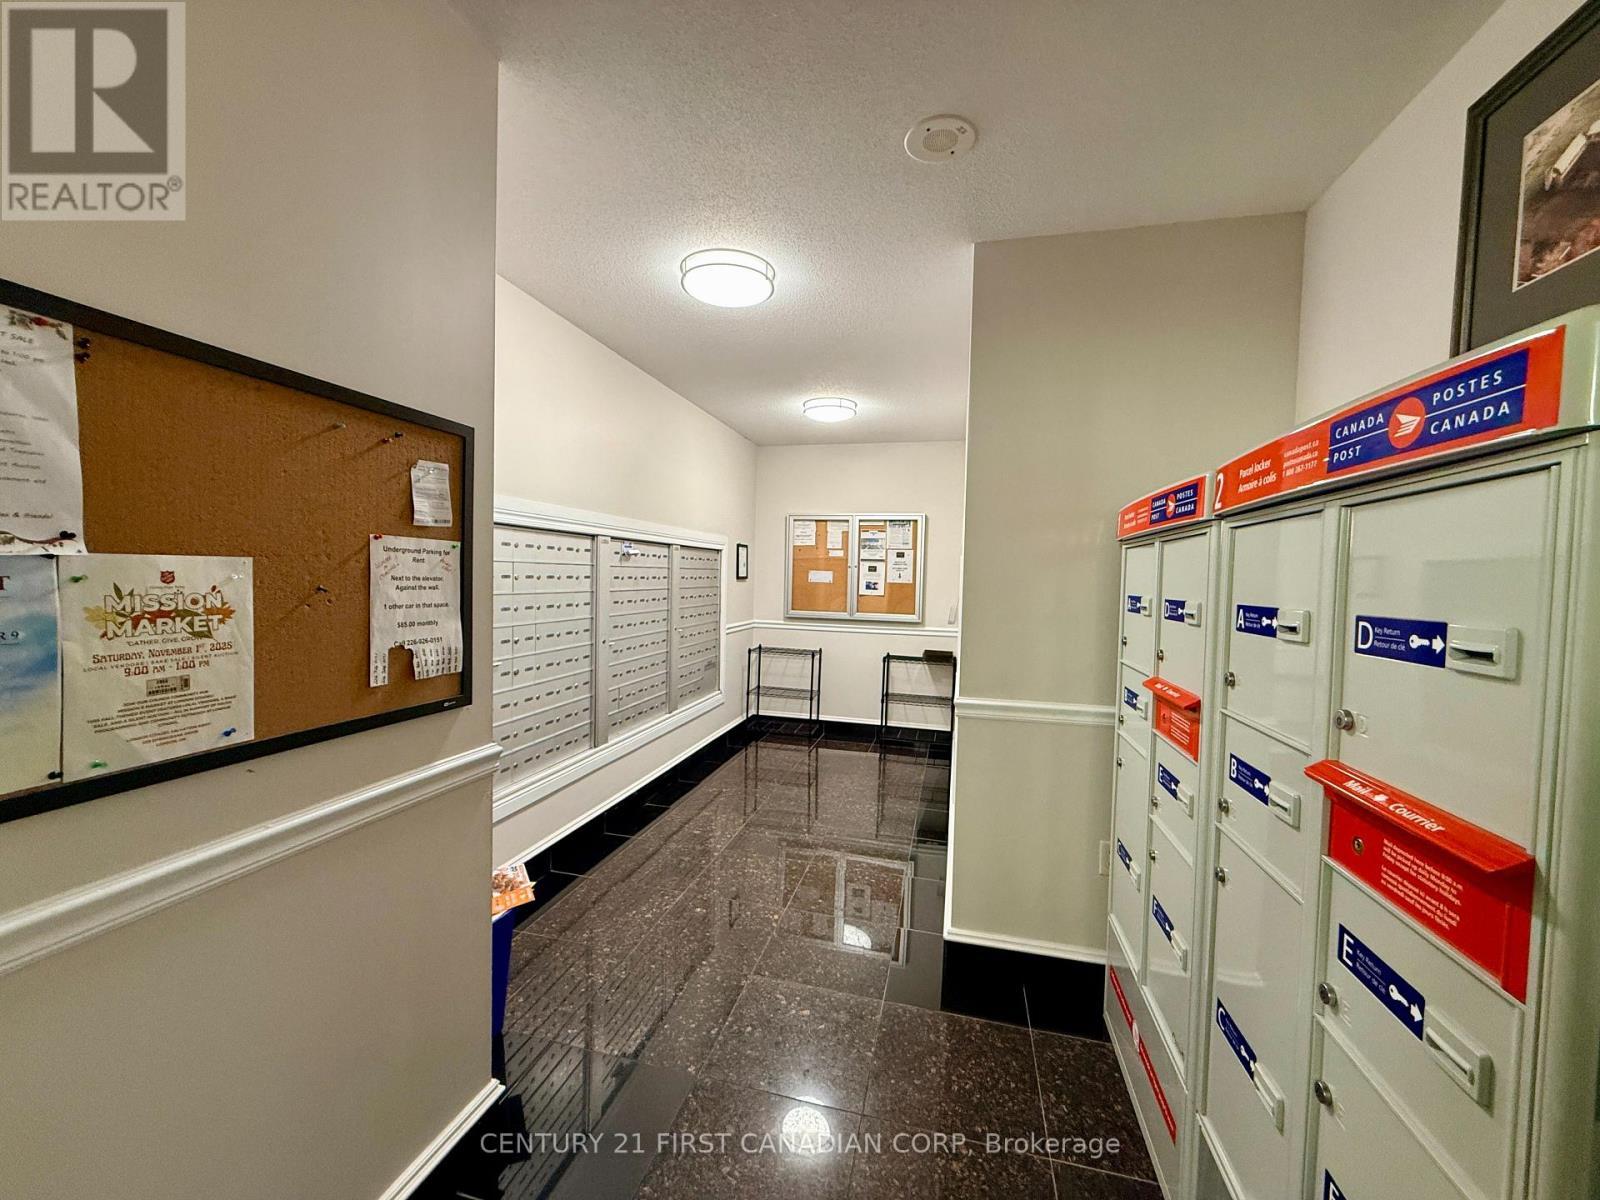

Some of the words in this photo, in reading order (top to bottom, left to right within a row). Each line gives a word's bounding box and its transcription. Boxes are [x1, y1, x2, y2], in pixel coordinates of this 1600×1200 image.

[1432, 369, 1503, 406] POSTES
[1335, 412, 1385, 439] CANADA
[1430, 401, 1510, 435] CANADA
[1333, 445, 1362, 463] POST
[1239, 464, 1254, 479] Parcel
[1254, 458, 1272, 472] locker
[1214, 472, 1225, 510] 2
[1238, 480, 1258, 493] Armoire
[1263, 471, 1278, 483] colis
[1152, 498, 1166, 508] CANADA
[1176, 489, 1194, 500] POSTES
[1151, 512, 1160, 521] POST
[1175, 503, 1195, 514] CANADA
[383, 545, 422, 554] Underground
[422, 548, 442, 556] Parking
[395, 584, 417, 592] Against
[104, 592, 223, 614] MISSION
[1164, 602, 1170, 617] D
[105, 615, 223, 641] MARKET
[1236, 608, 1245, 629] A
[1358, 620, 1373, 649] D
[1374, 626, 1382, 636] Key
[1383, 626, 1401, 636] Return
[149, 646, 193, 659] NOVEMBER
[209, 641, 233, 652] 2025
[1374, 640, 1390, 649] Retour
[124, 665, 149, 677] 9:00
[153, 665, 166, 673] AM
[176, 660, 196, 670] 1:00
[199, 659, 210, 668] PM
[1230, 757, 1237, 779] B
[1342, 779, 1374, 795] Mail
[1388, 803, 1446, 832] Courrier
[1342, 932, 1355, 967] E
[1218, 1007, 1226, 1031] C
